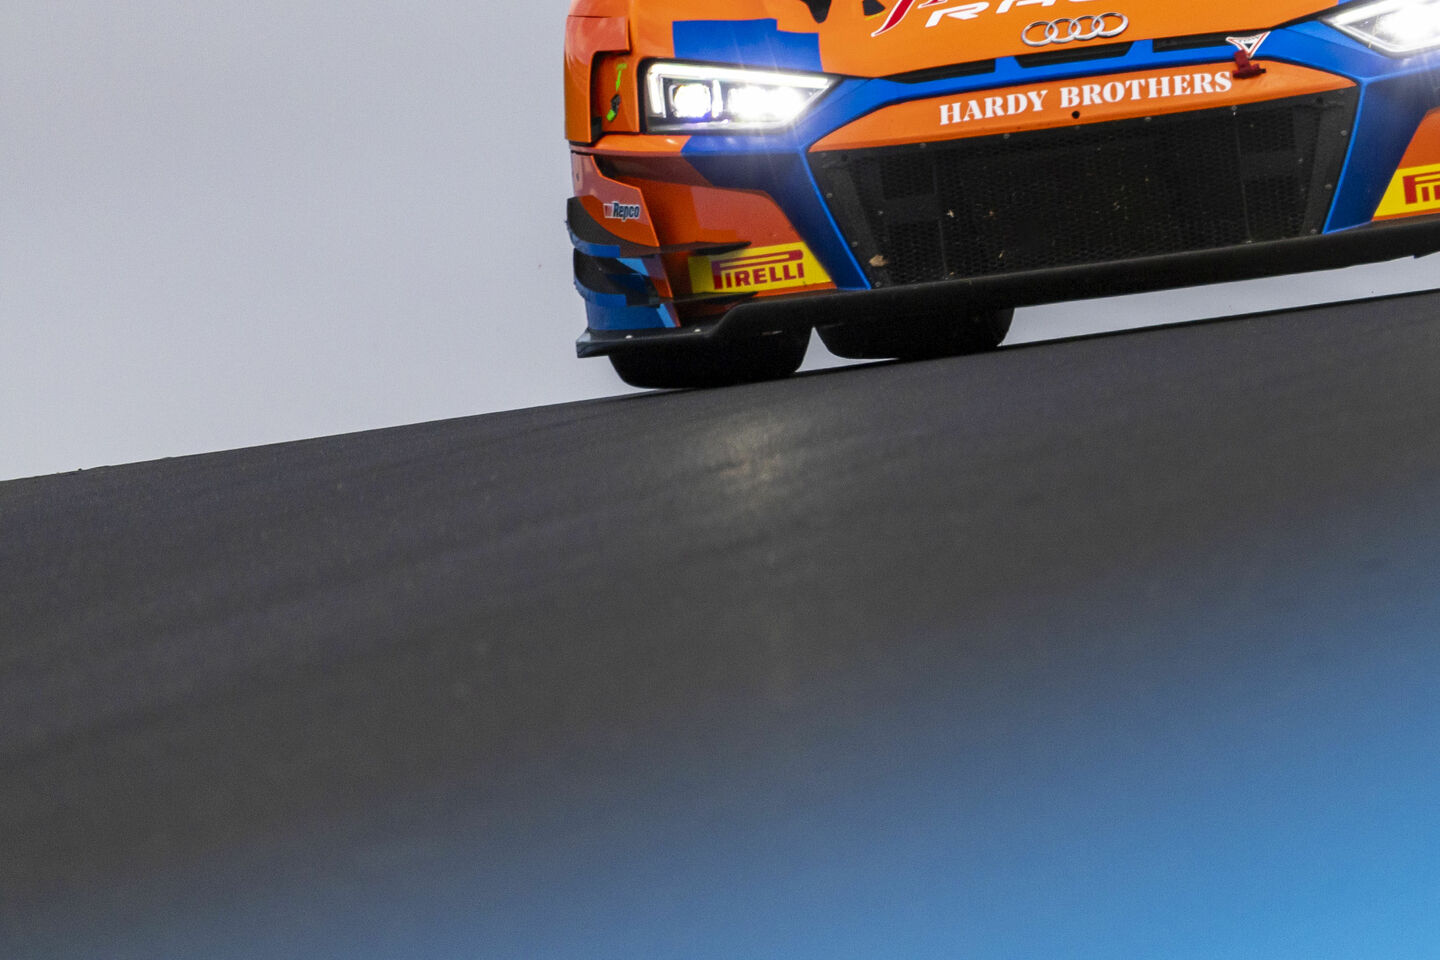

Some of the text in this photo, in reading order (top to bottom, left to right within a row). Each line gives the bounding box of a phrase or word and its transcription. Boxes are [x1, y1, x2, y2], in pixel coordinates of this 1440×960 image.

[938, 70, 1233, 126] HARDY BROTHERS
[612, 201, 641, 221] Repco
[711, 248, 805, 291] PIRELLI
